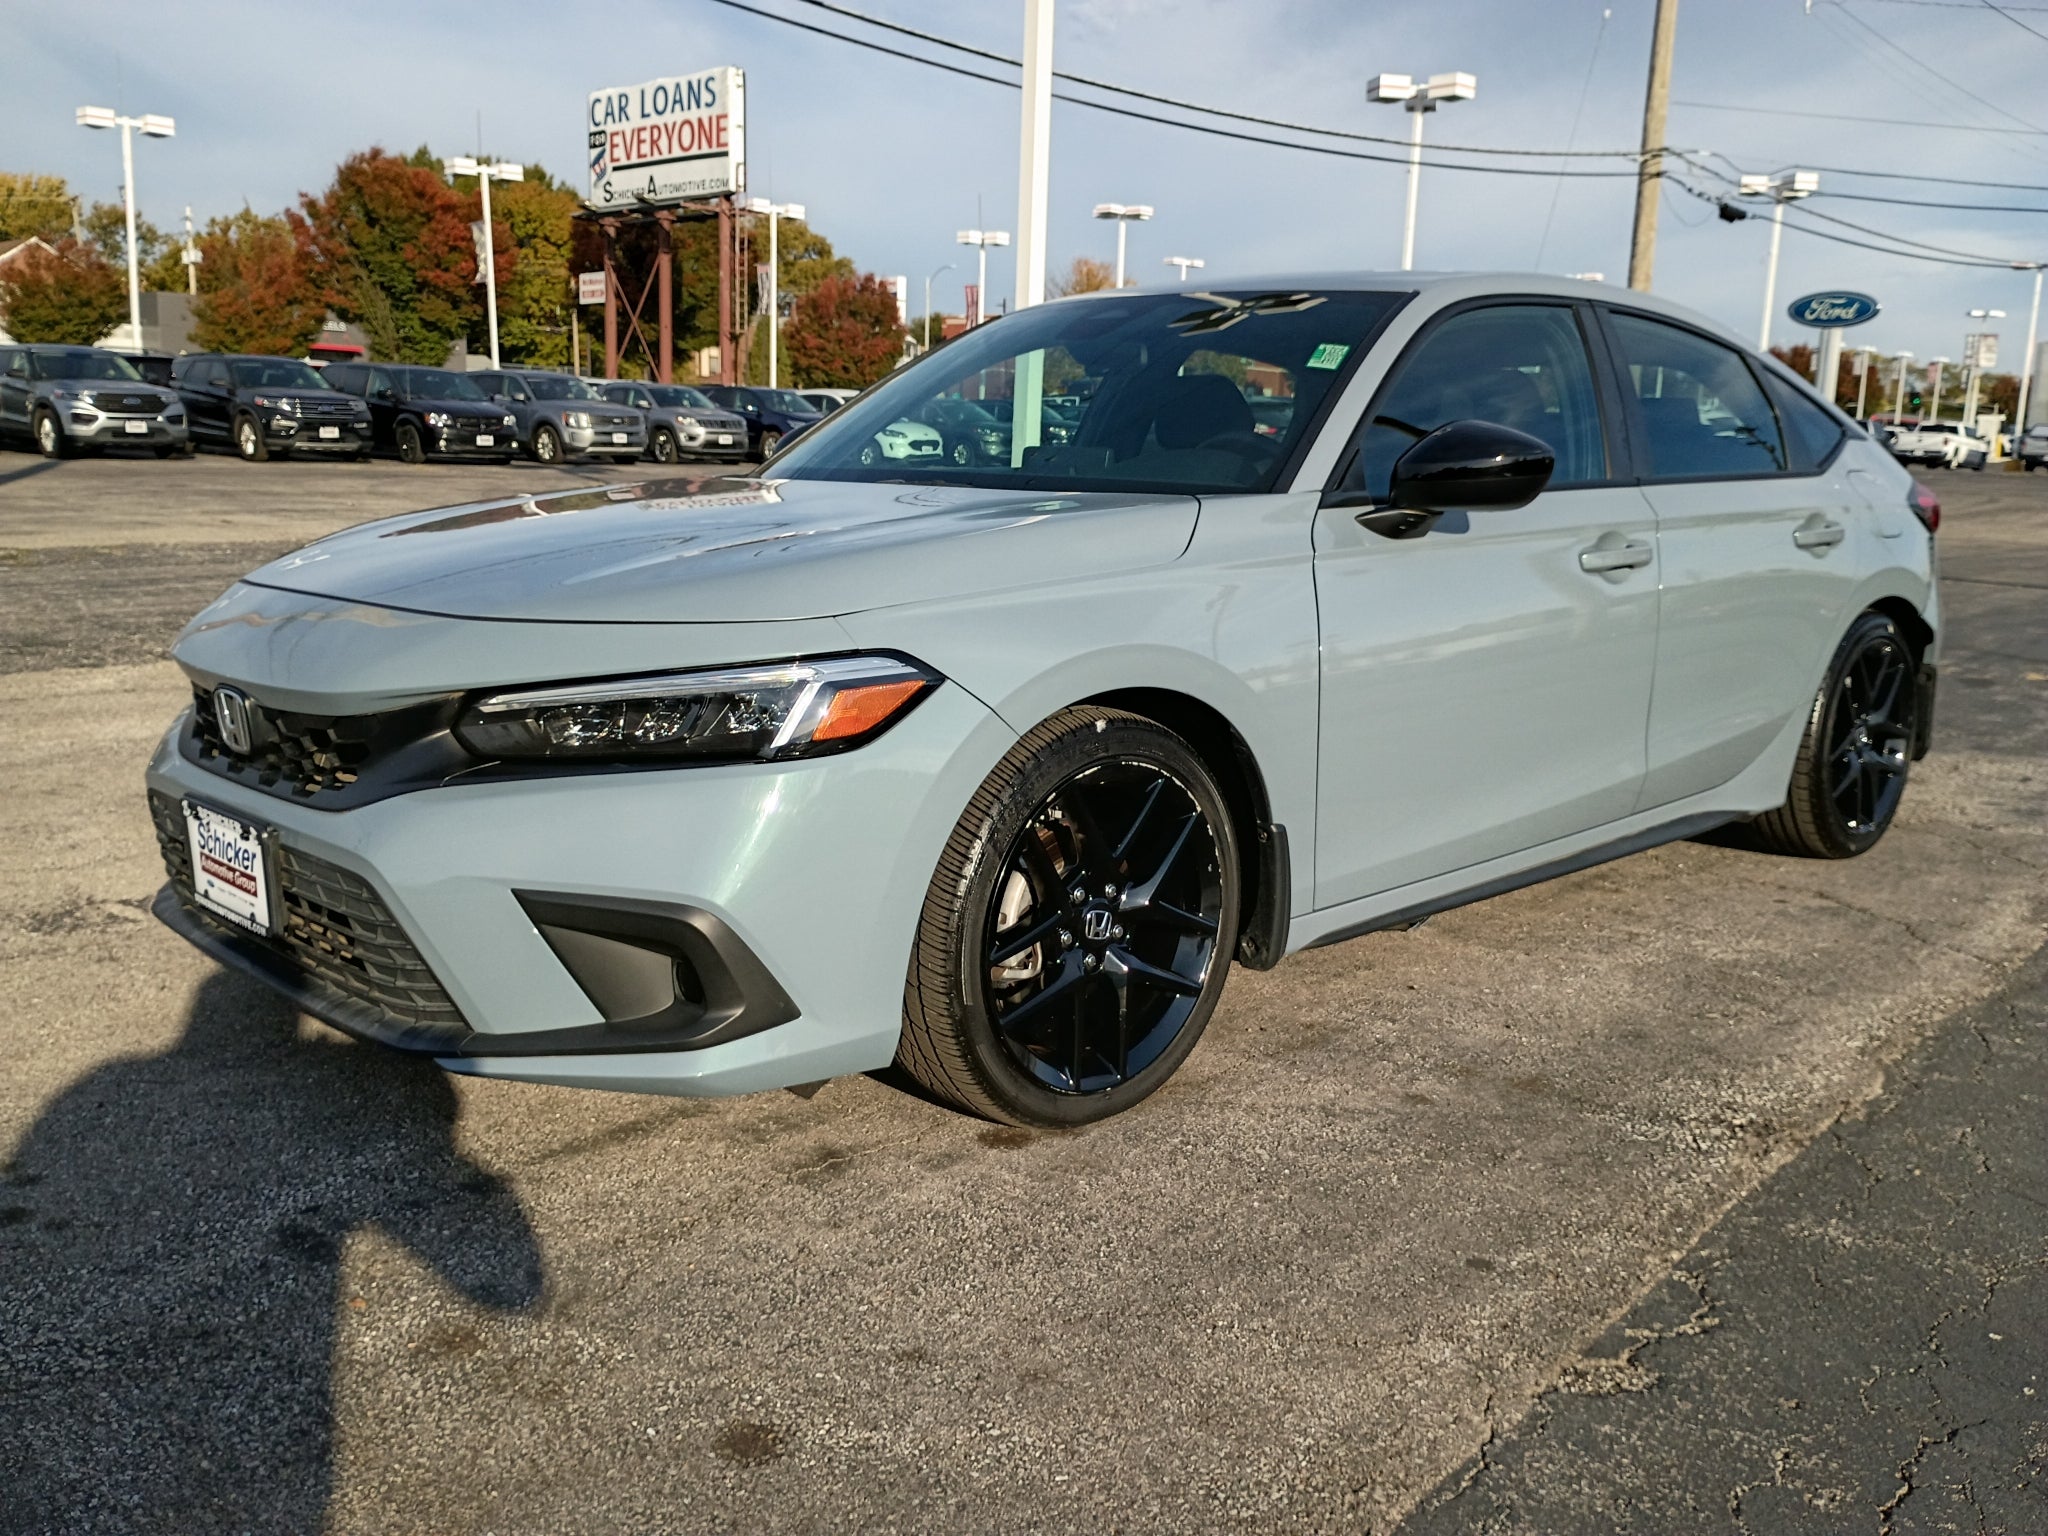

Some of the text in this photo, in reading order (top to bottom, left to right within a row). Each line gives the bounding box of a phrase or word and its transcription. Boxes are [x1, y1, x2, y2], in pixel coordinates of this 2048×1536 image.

[591, 76, 717, 127] CAR LOANS
[609, 114, 729, 164] EVERYONE
[1803, 297, 1861, 321] Ford
[197, 820, 257, 873] Schicker
[234, 871, 257, 894] Group
